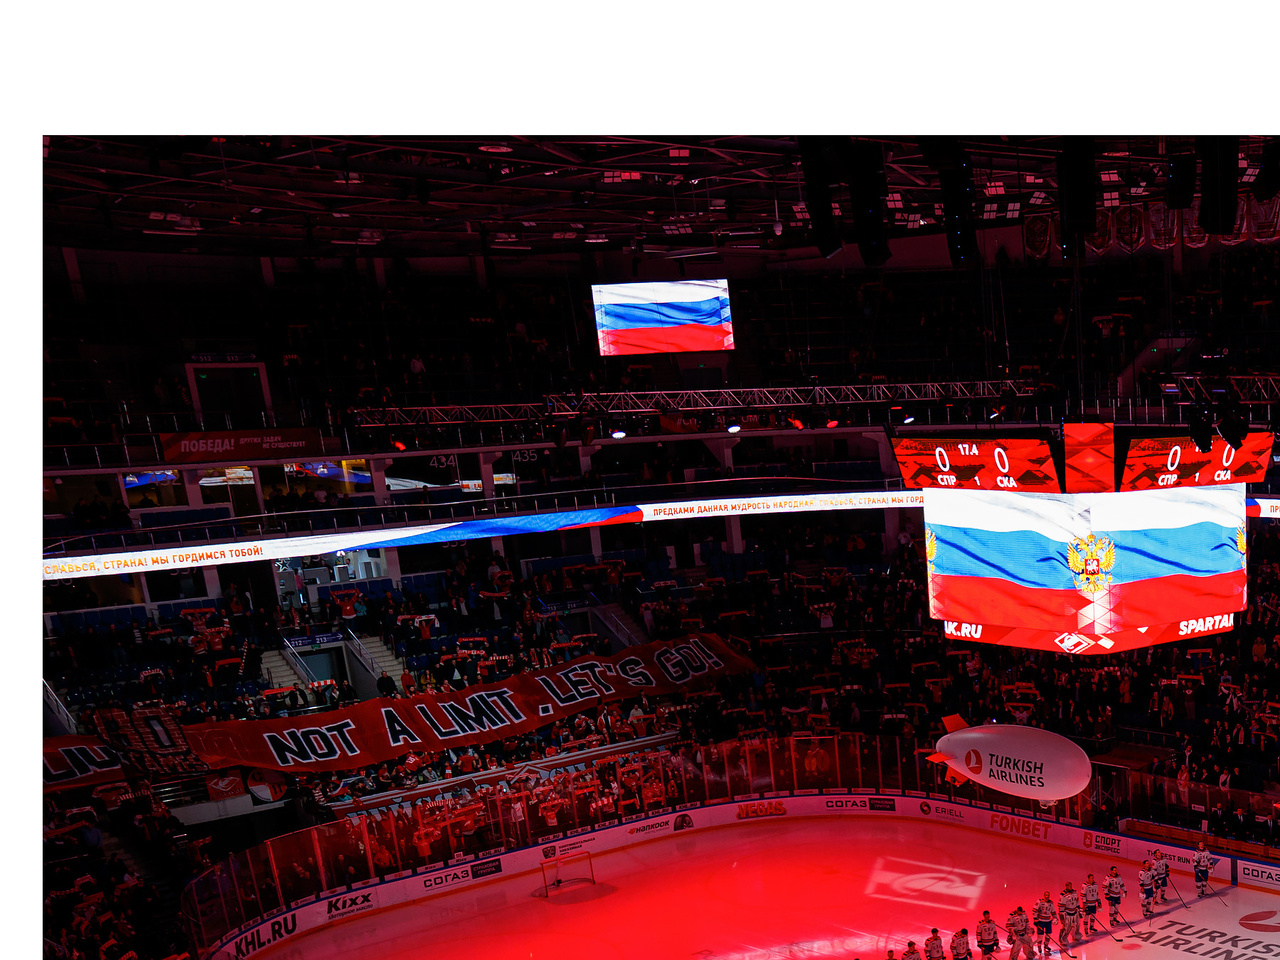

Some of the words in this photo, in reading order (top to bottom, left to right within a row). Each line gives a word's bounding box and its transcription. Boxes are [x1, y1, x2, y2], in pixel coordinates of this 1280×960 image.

[180, 438, 235, 453] ПОБЕДА!
[957, 443, 979, 456] 17.4
[429, 454, 456, 469] 434
[513, 448, 538, 464] 435
[935, 447, 950, 472] 0
[994, 447, 1010, 473] 0
[1167, 445, 1181, 472] 0
[937, 474, 957, 486] СПР
[996, 475, 1018, 488] СКА
[1158, 474, 1178, 487] СПР
[1214, 470, 1231, 482] СКА
[653, 506, 695, 517] ПРЕДКАМИ
[697, 503, 729, 514] ДАННАЯ
[730, 501, 771, 512] МУДРОСТЬ
[858, 496, 890, 505] СТРАНА!
[891, 496, 904, 504] МЫ
[44, 563, 100, 575] СЛАВЬСЯ,
[103, 557, 148, 570] СТРАНА!
[151, 555, 169, 565] МЫ
[172, 551, 226, 564] ГОРДИМСЯ
[229, 546, 263, 558] ТОБОЙ!
[263, 719, 362, 766] NOT
[381, 707, 421, 747] A
[654, 638, 724, 683] GO!
[988, 752, 1044, 775] TURKISH
[987, 767, 1045, 788] AIRLINES
[737, 800, 787, 820] VEGAS
[825, 799, 868, 809] СОГАЗ
[935, 806, 964, 819] ERIELL
[990, 813, 1052, 840] FONBET
[1094, 844, 1121, 854] ЭКСПРЕСС
[1095, 835, 1121, 848] СПОРТ
[1177, 855, 1191, 865] RUN
[423, 868, 470, 888] СОГАЗ
[327, 892, 372, 914] Kixx
